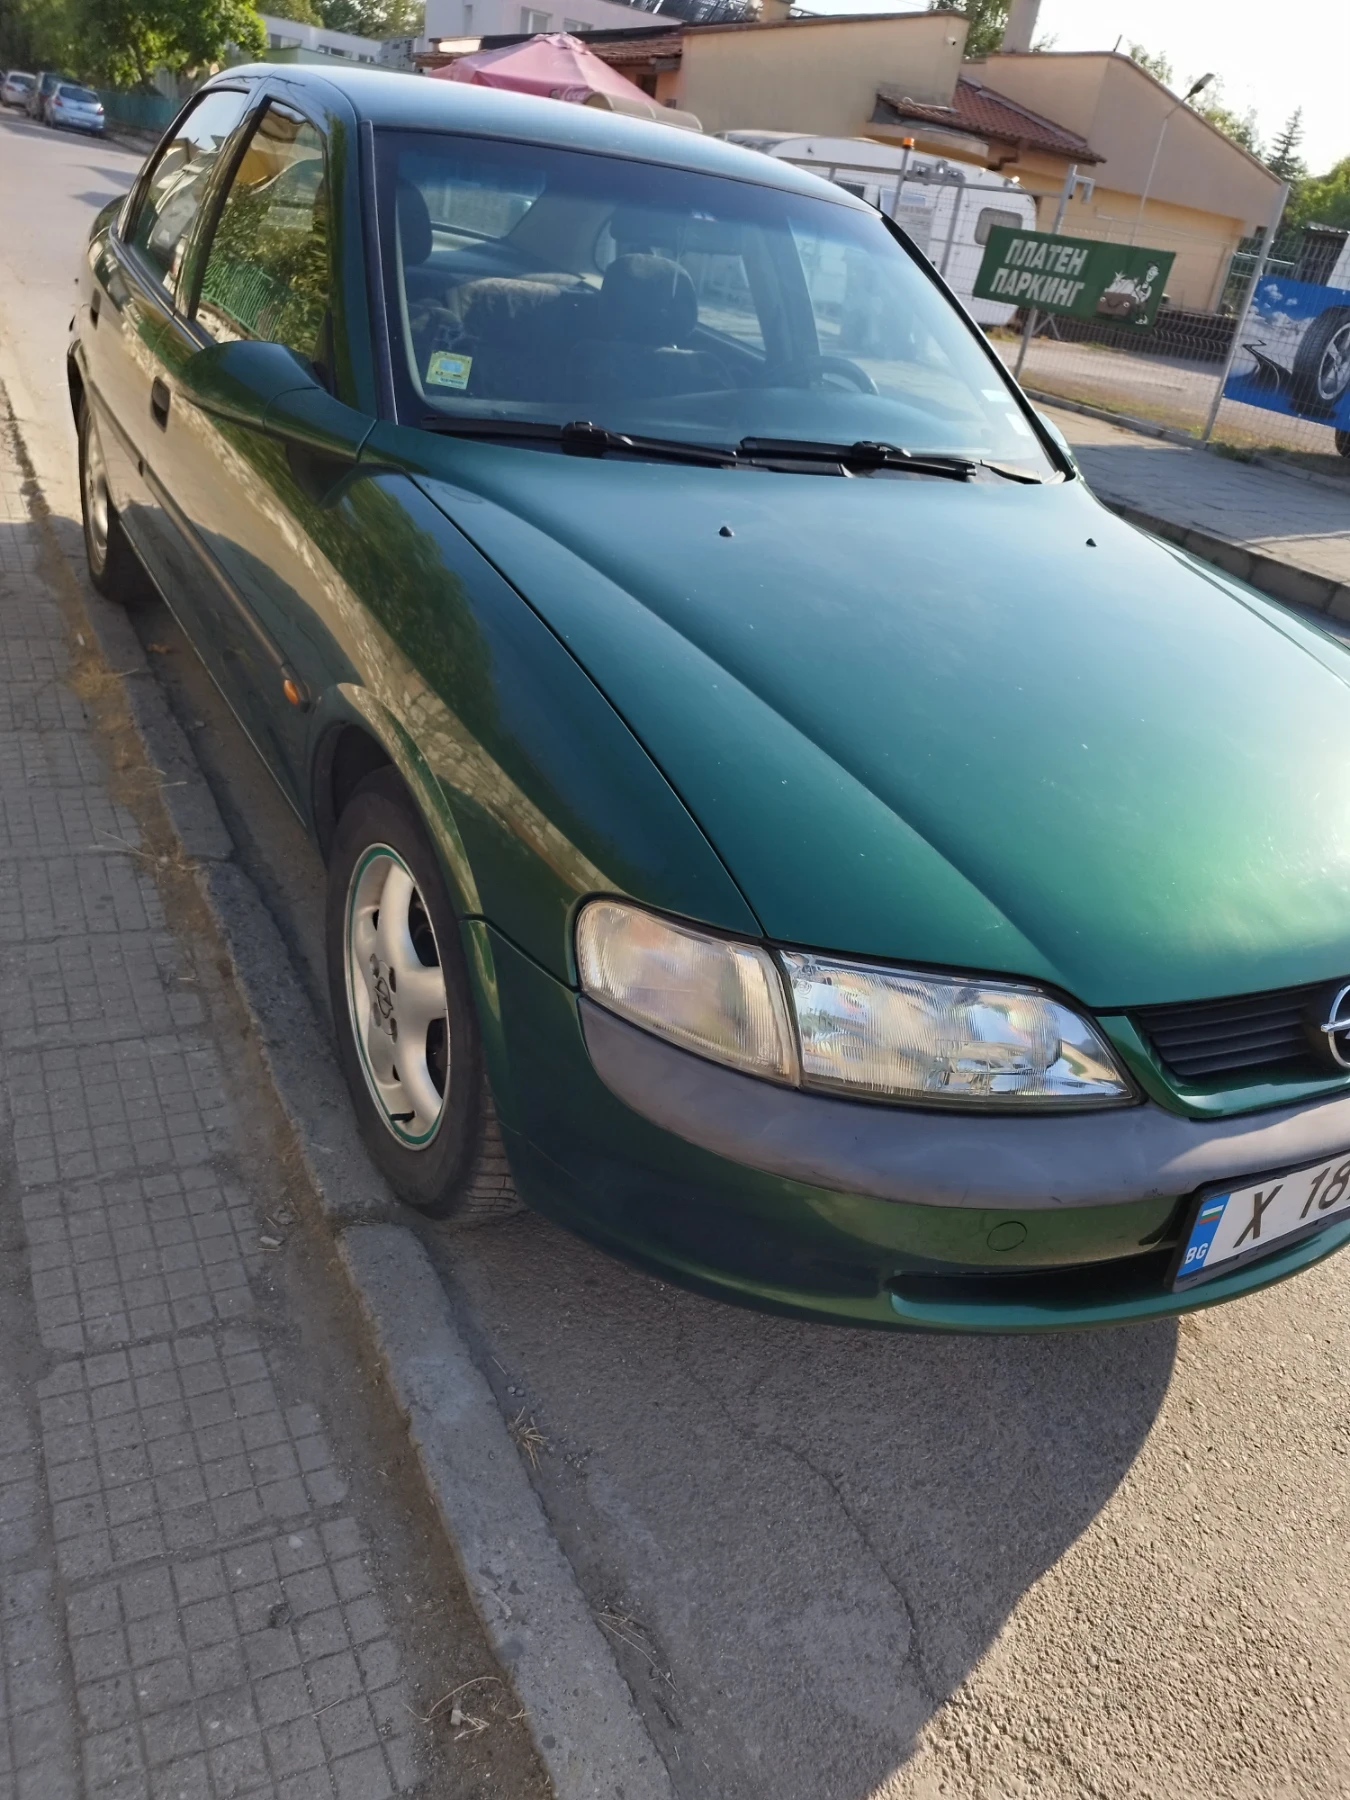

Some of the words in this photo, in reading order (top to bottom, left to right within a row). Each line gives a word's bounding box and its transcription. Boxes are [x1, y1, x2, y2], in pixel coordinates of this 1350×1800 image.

[1004, 238, 1088, 275] ПЛАТЕН
[989, 267, 1085, 307] ПАРКИНГ
[1299, 1160, 1350, 1220] 18
[1184, 1243, 1208, 1265] BG
